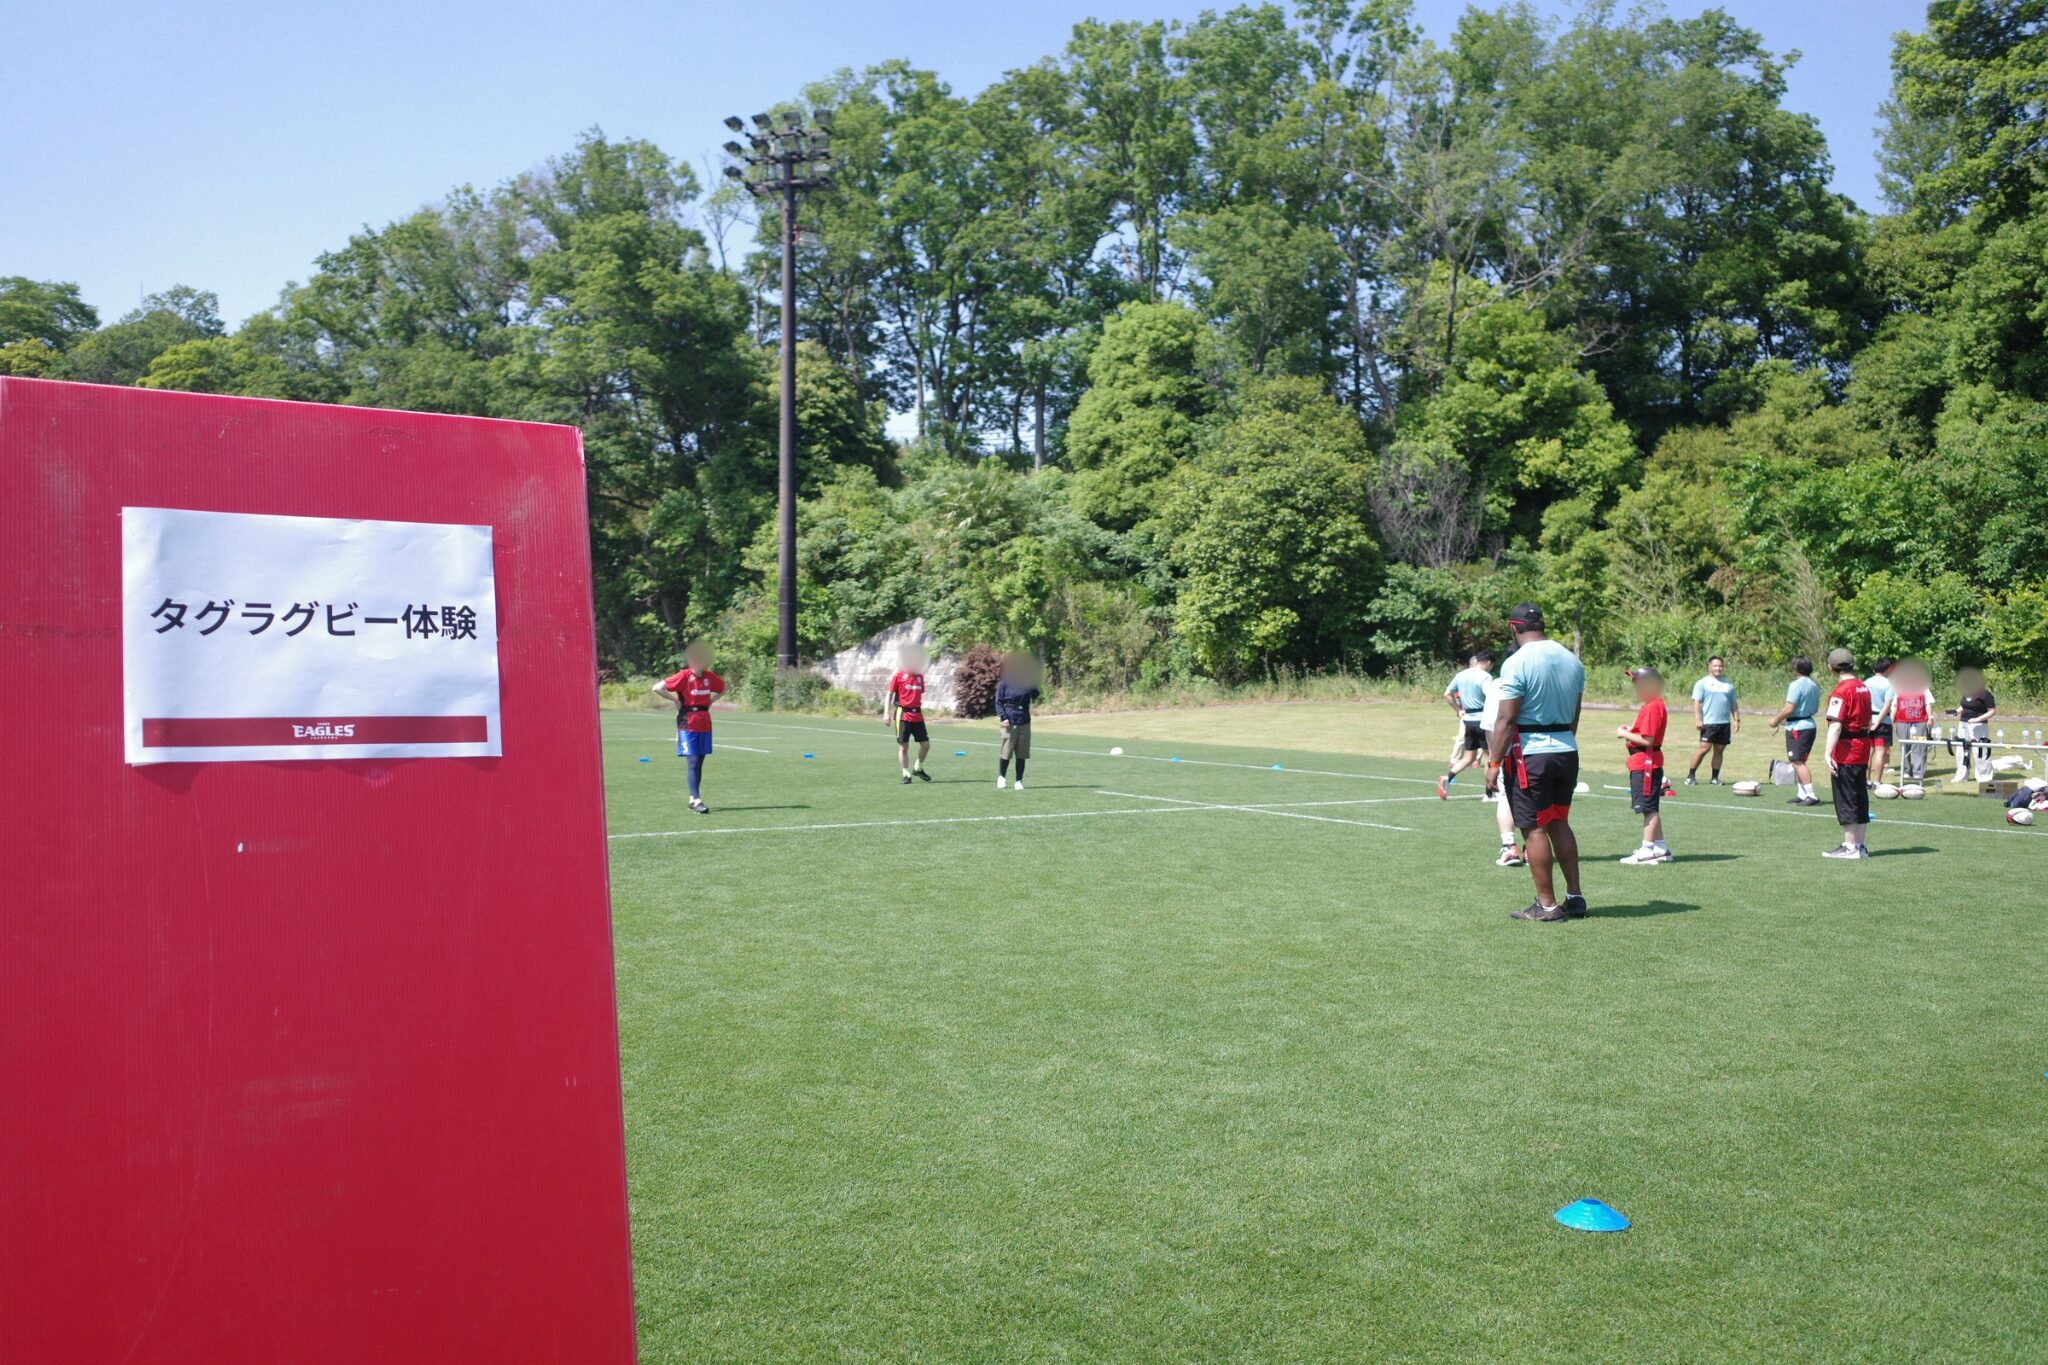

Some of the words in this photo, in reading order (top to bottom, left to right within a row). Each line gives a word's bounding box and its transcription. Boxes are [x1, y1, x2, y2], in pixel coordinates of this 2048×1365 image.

[151, 597, 478, 641] タグラグビー体験
[292, 724, 355, 738] EAGLES
